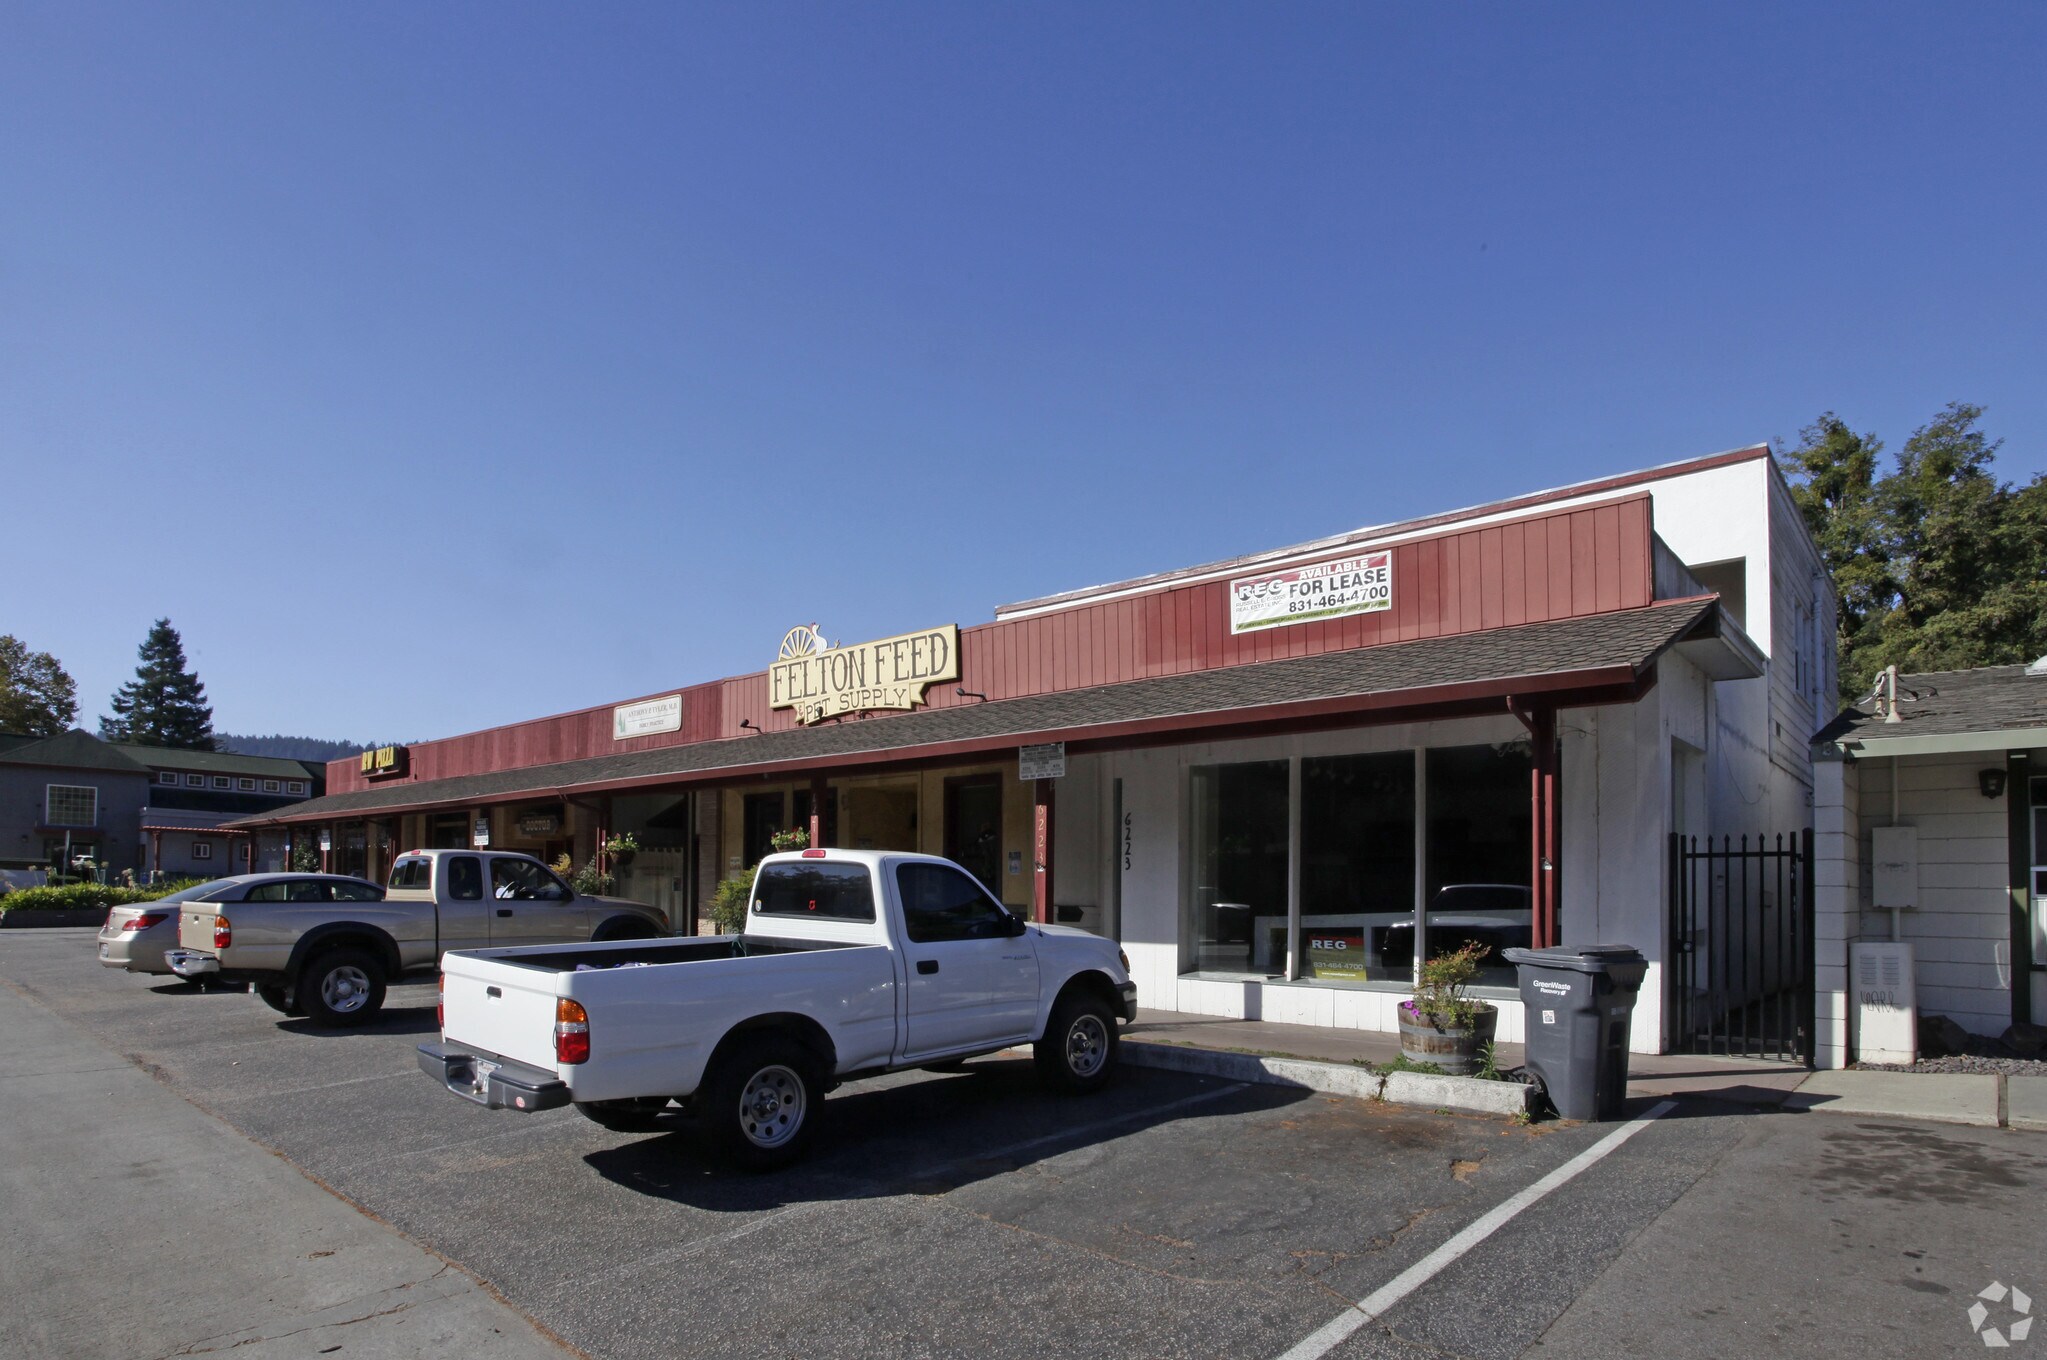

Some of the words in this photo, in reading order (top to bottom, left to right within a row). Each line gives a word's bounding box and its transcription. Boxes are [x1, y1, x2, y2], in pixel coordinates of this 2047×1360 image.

[1298, 558, 1369, 580] AVAILABLE
[1237, 578, 1284, 601] REG
[1289, 579, 1323, 598] FOR
[1330, 568, 1387, 591] LEASE
[1289, 585, 1388, 613] 831-464-4700
[773, 648, 866, 703] FELTON
[874, 632, 948, 685] FEED
[839, 688, 907, 711] SUPPLY
[376, 746, 394, 769] PIZZA
[1124, 812, 1132, 870] 6223
[1311, 940, 1347, 950] REG
[1533, 980, 1571, 991] GreenWaste
[1540, 987, 1561, 996] Recovery
